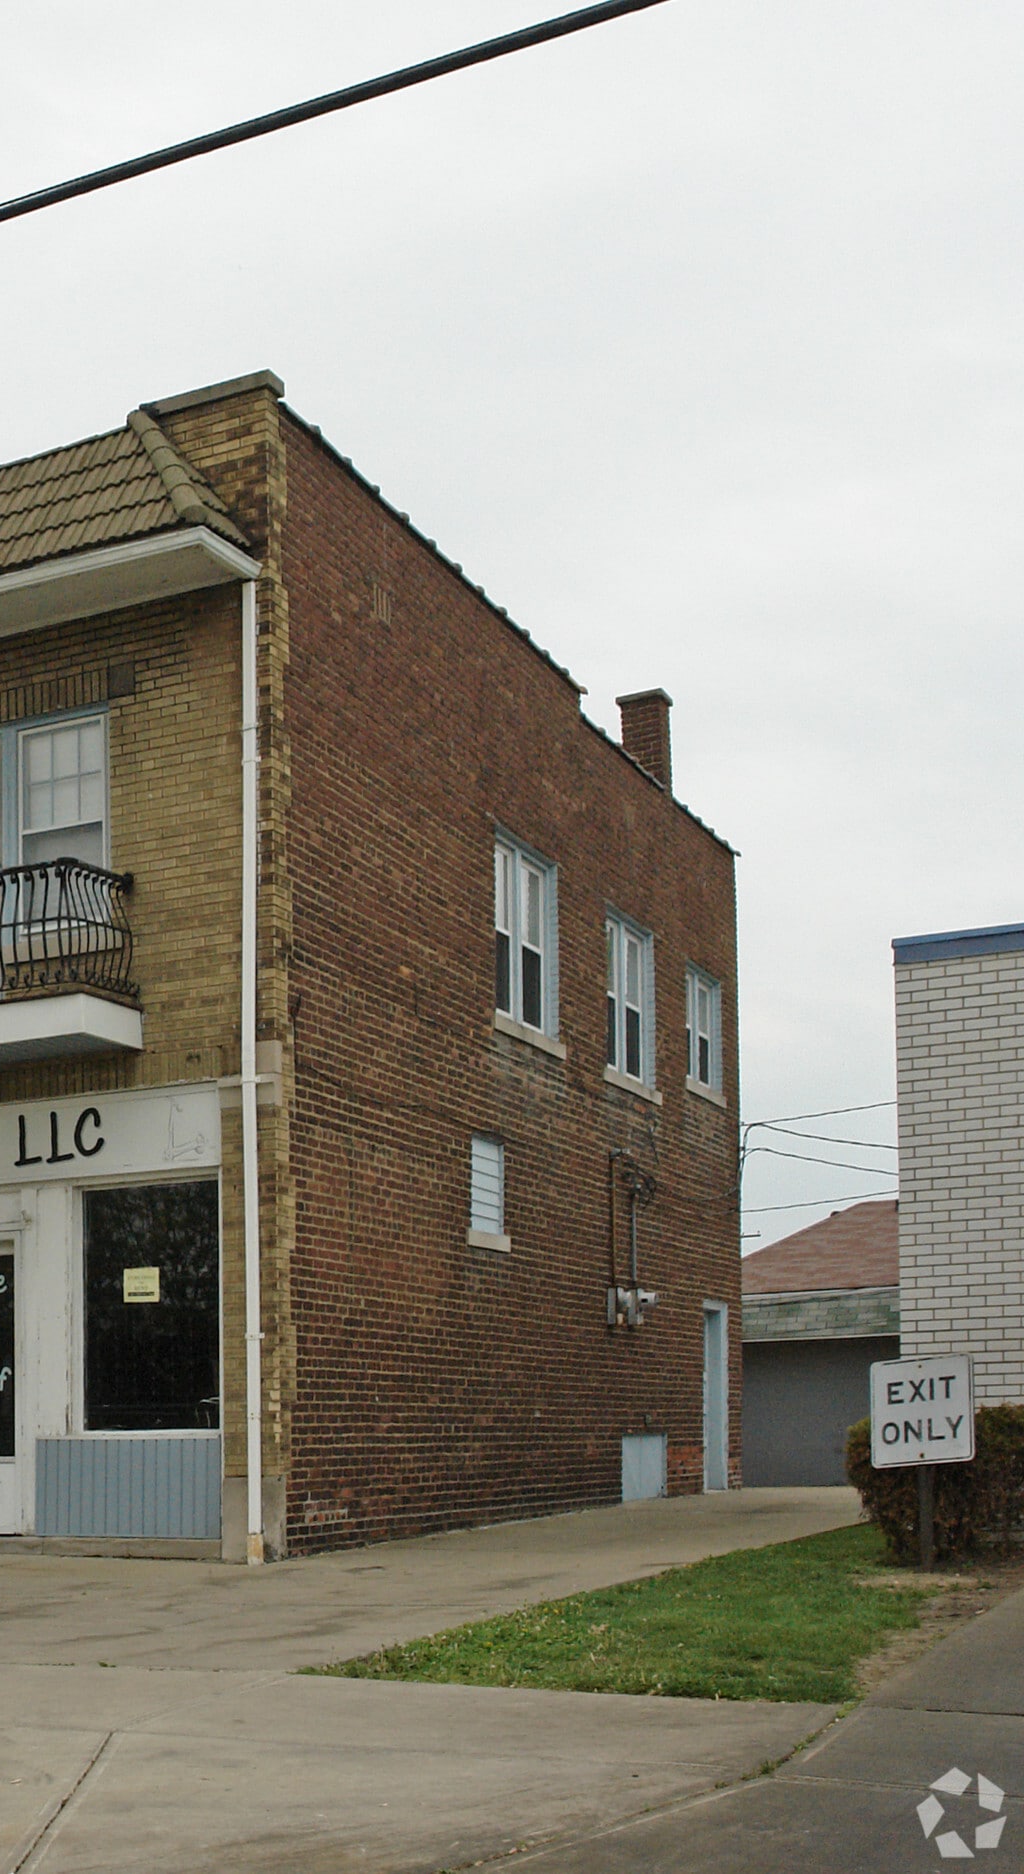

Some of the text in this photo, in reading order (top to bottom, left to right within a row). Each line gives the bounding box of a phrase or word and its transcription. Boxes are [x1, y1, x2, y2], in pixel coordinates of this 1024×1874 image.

[14, 1107, 105, 1167] LLC
[887, 1375, 956, 1405] EXIT
[882, 1415, 964, 1445] ONLY
